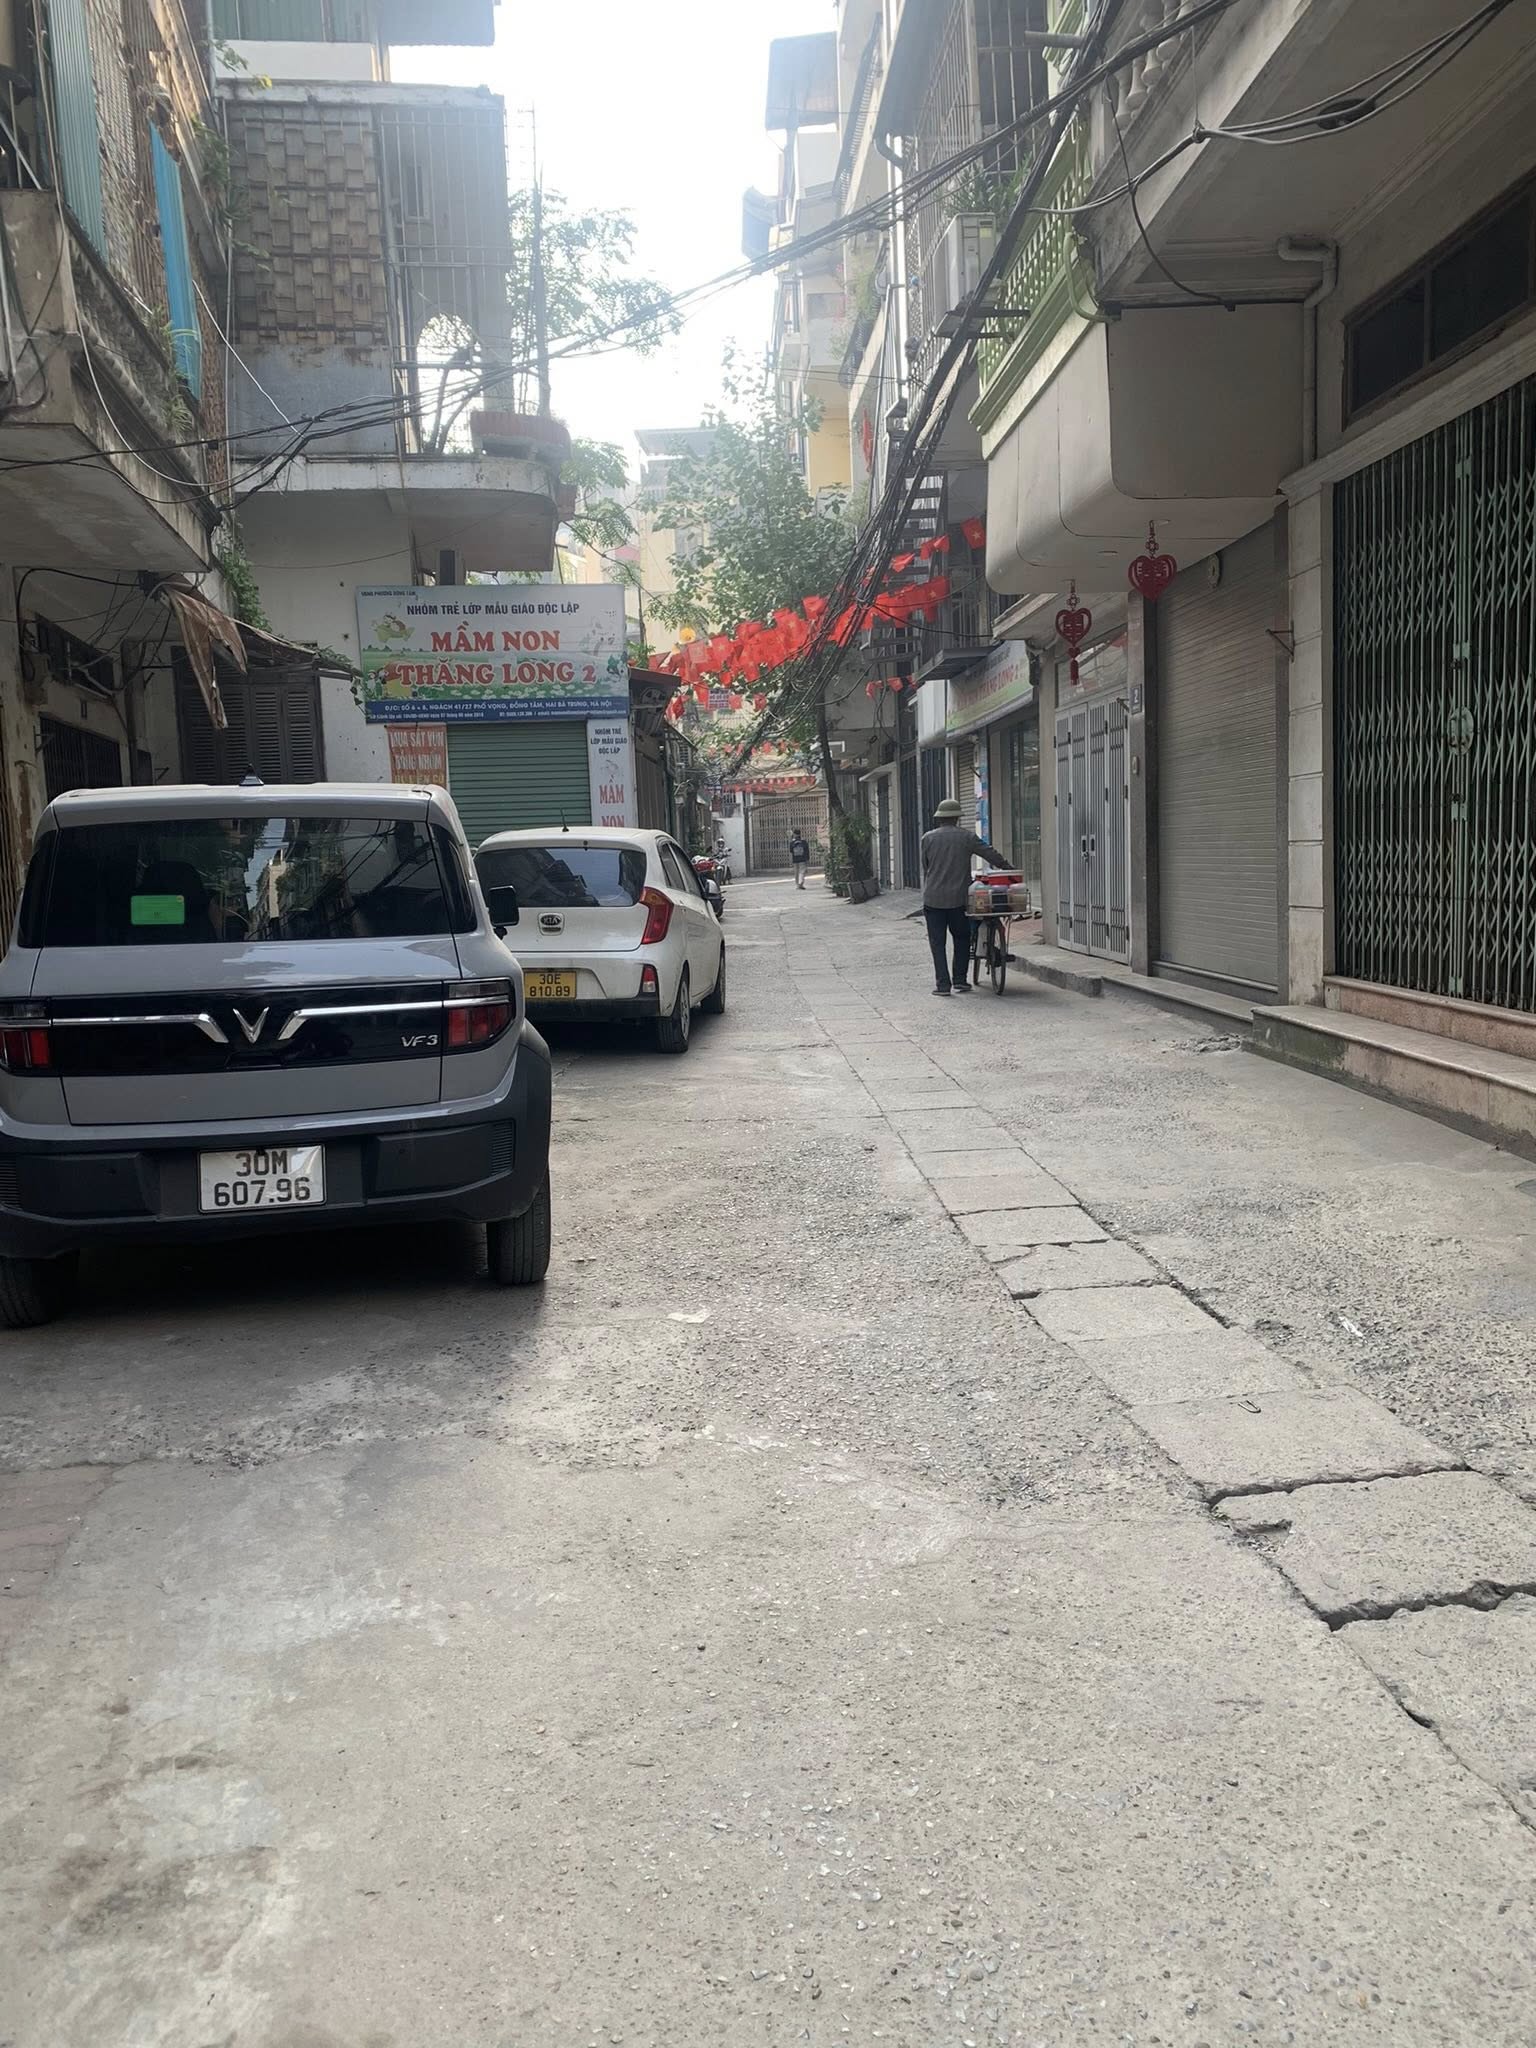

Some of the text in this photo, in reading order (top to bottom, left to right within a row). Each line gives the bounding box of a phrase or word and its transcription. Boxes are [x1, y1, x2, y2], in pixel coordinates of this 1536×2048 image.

[407, 602, 438, 616] NHÓM
[441, 601, 462, 615] TRẺ
[463, 602, 482, 615] LỚP
[511, 601, 535, 614] GIÁO
[538, 602, 558, 616] ĐỘC
[561, 602, 580, 616] LẬP
[430, 620, 560, 653] MẦM NON
[396, 656, 495, 686] THĂNG
[582, 664, 597, 684] 2
[599, 775, 625, 804] MẦM
[542, 916, 560, 925] KIA
[529, 986, 570, 997] 810.89
[539, 973, 562, 985] 30E
[235, 1150, 288, 1177] 30M
[214, 1177, 311, 1207] 607.96
